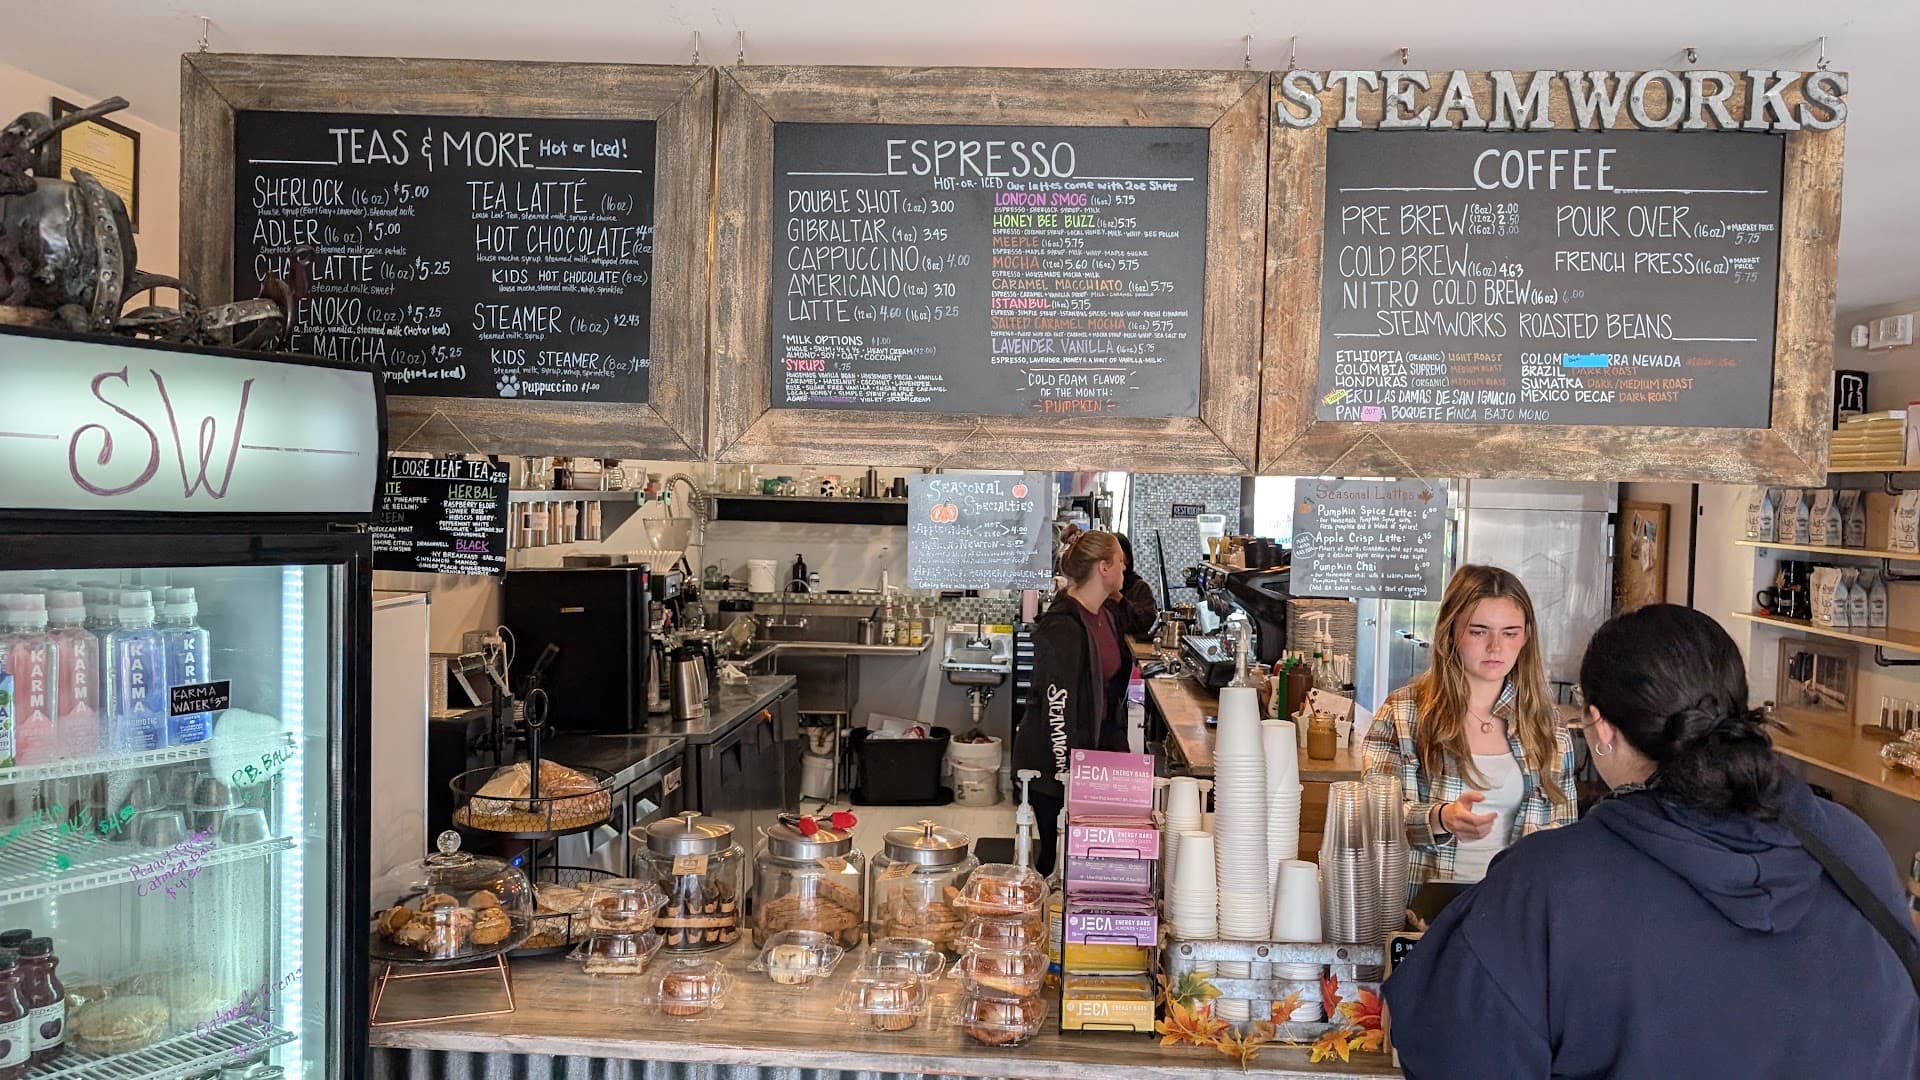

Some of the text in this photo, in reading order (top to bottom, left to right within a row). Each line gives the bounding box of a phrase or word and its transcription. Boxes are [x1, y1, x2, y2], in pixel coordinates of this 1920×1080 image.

[1276, 69, 1848, 131] STEAMWORKS
[329, 128, 628, 173] TEAS & MORE Hot or Iced!
[886, 139, 1076, 178] ESPRESSO
[1473, 149, 1616, 190] COFFEE
[253, 175, 430, 208] SHERLOCK $5.00
[466, 181, 507, 211] TEA
[995, 192, 1087, 207] LONDON SMOG
[788, 189, 955, 213] DOUBLE SHOT 3.00
[1497, 203, 1519, 214] 2.00
[993, 215, 1096, 228] HONEY BEE BUZZ
[1342, 203, 1468, 236] PRE BREW
[1557, 205, 1692, 239] POUR OVER
[253, 218, 401, 247] ADLER $5.00
[787, 213, 888, 243] GIBRALTAR
[476, 225, 634, 258] HOT CHOCOLATE
[992, 237, 1039, 248] MEEPLE
[787, 246, 919, 271] CAPPUCCINO
[992, 256, 1088, 270] MOCHA 5.60
[1339, 245, 1396, 278] COLD
[1401, 243, 1468, 278] BREW
[1555, 251, 1695, 275] FRENCH PRESS
[312, 254, 450, 281] LATTE $5.25
[492, 269, 621, 284] KIDS HOT CHOCOLATE
[787, 273, 900, 298] AMERICANO
[991, 278, 1048, 291] CARAMEL
[1055, 279, 1123, 292] MACCHIATO
[1343, 279, 1531, 309] NITRO COLD BREW
[788, 299, 850, 322] LATTE
[991, 298, 1051, 310] ISTANBUL
[407, 303, 442, 324] $5.25
[472, 302, 562, 334] STEAMER
[991, 317, 1126, 330] SALTED CARAMEL MOCHA
[1376, 310, 1673, 340] STEAMWORKS ROASTED BEANS
[786, 335, 863, 346] MILK OPTIONS
[991, 338, 1114, 355] LAVENDER VANILLA
[313, 335, 463, 366] MATCHA $5.25
[491, 348, 600, 369] KIDS STEAMER
[1335, 350, 1403, 363] ETHIOPIA
[785, 359, 825, 372] SYRUPS
[1632, 355, 1681, 367] NEVADA
[1335, 364, 1447, 376] COLOMBIA SUPREMO
[1521, 366, 1639, 377] BRAZIL ROAST
[1028, 373, 1126, 386] COLD FOAM FLAVOR
[1335, 376, 1407, 388] HONDURAS
[1521, 378, 1694, 390] SUMATRA ROAST
[522, 379, 578, 398] Puppuccino
[1040, 388, 1053, 397] OF
[1055, 388, 1073, 398] THE
[1521, 390, 1679, 403] MEXICO DECAF DARK ROAST
[1377, 390, 1396, 404] LAS
[1399, 390, 1431, 404] DAMAS
[1435, 391, 1450, 405] DE
[1452, 391, 1475, 405] SAN
[1477, 390, 1516, 405] IGNACIO
[1044, 399, 1103, 413] PUMPKIN
[1391, 406, 1550, 421] BOQUETE FINCA BAJO MONO
[69, 365, 255, 500] SW
[393, 459, 489, 479] LOOSE LEAF TEA
[448, 484, 498, 499] HERBAL
[1316, 483, 1370, 500] Seasonal
[1318, 504, 1356, 517] Pumpkin
[1360, 505, 1386, 516] Spice
[455, 539, 490, 550] BLACK
[1315, 532, 1344, 544] Apple
[1348, 532, 1374, 545] Crisp
[1313, 561, 1377, 572] Pumpkin Chai
[74, 640, 88, 713] KARMA
[130, 644, 146, 713] KARMA
[30, 649, 45, 721] KARMA
[173, 685, 217, 701] KARMA
[172, 699, 211, 713] WATER
[1074, 765, 1109, 782] JECA
[1083, 828, 1115, 844] JECA
[1080, 916, 1112, 931] JECA
[1077, 1002, 1109, 1017] JECA
